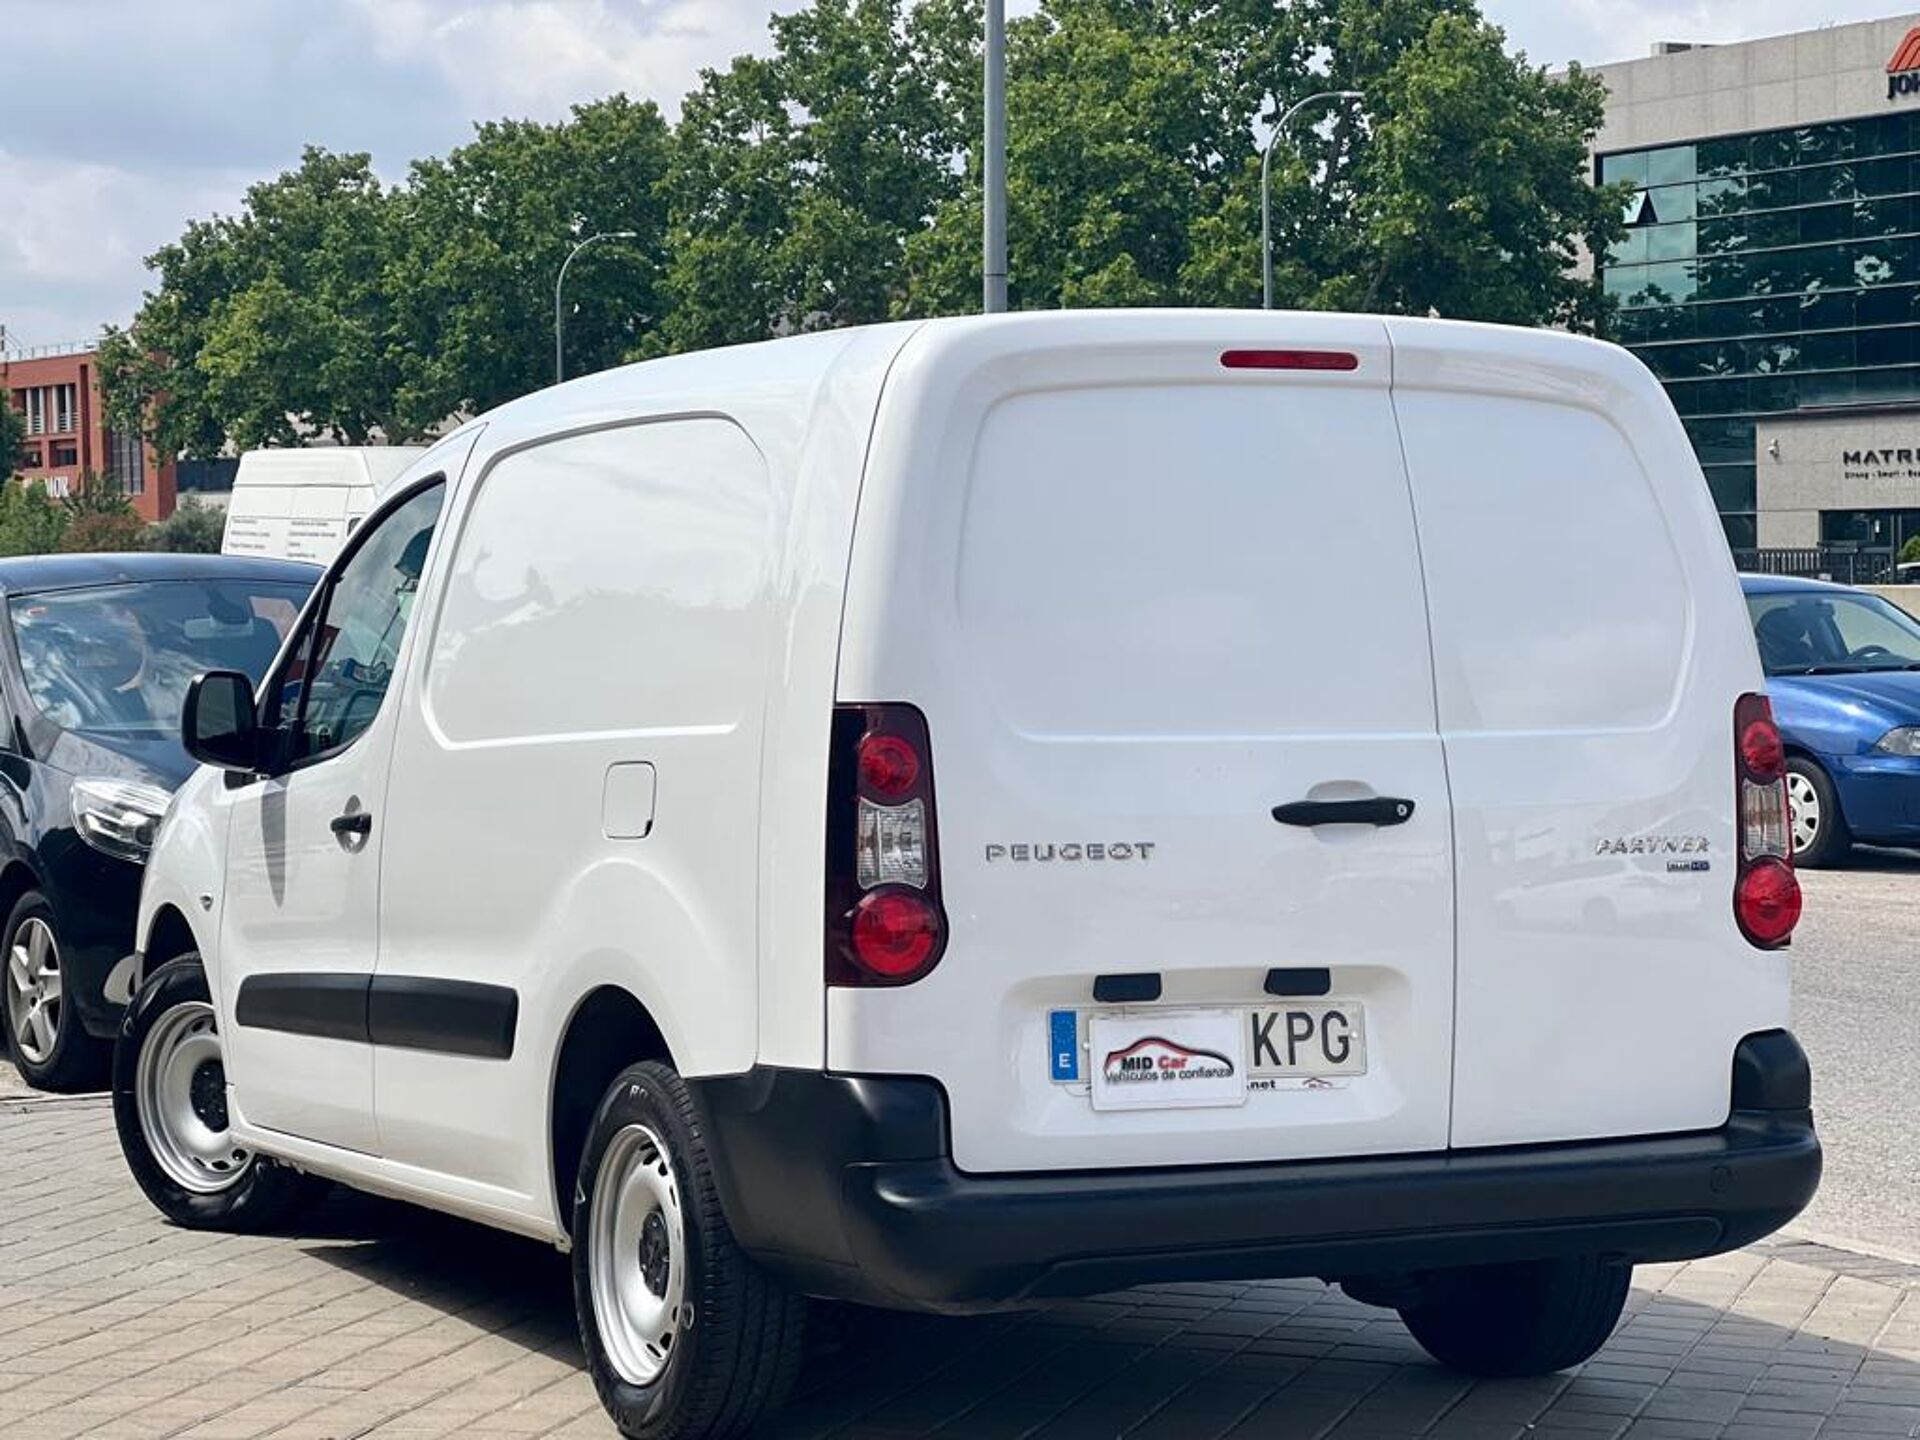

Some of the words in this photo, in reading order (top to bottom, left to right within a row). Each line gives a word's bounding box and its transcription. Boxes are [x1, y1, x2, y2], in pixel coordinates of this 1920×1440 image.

[986, 842, 1156, 862] PEUGEOT
[1596, 836, 1710, 855] PARTNER
[1251, 1010, 1350, 1068] KPG
[1059, 1053, 1071, 1068] E
[1121, 1056, 1153, 1070] MID
[1158, 1056, 1188, 1069] Car
[1162, 1069, 1176, 1080] de
